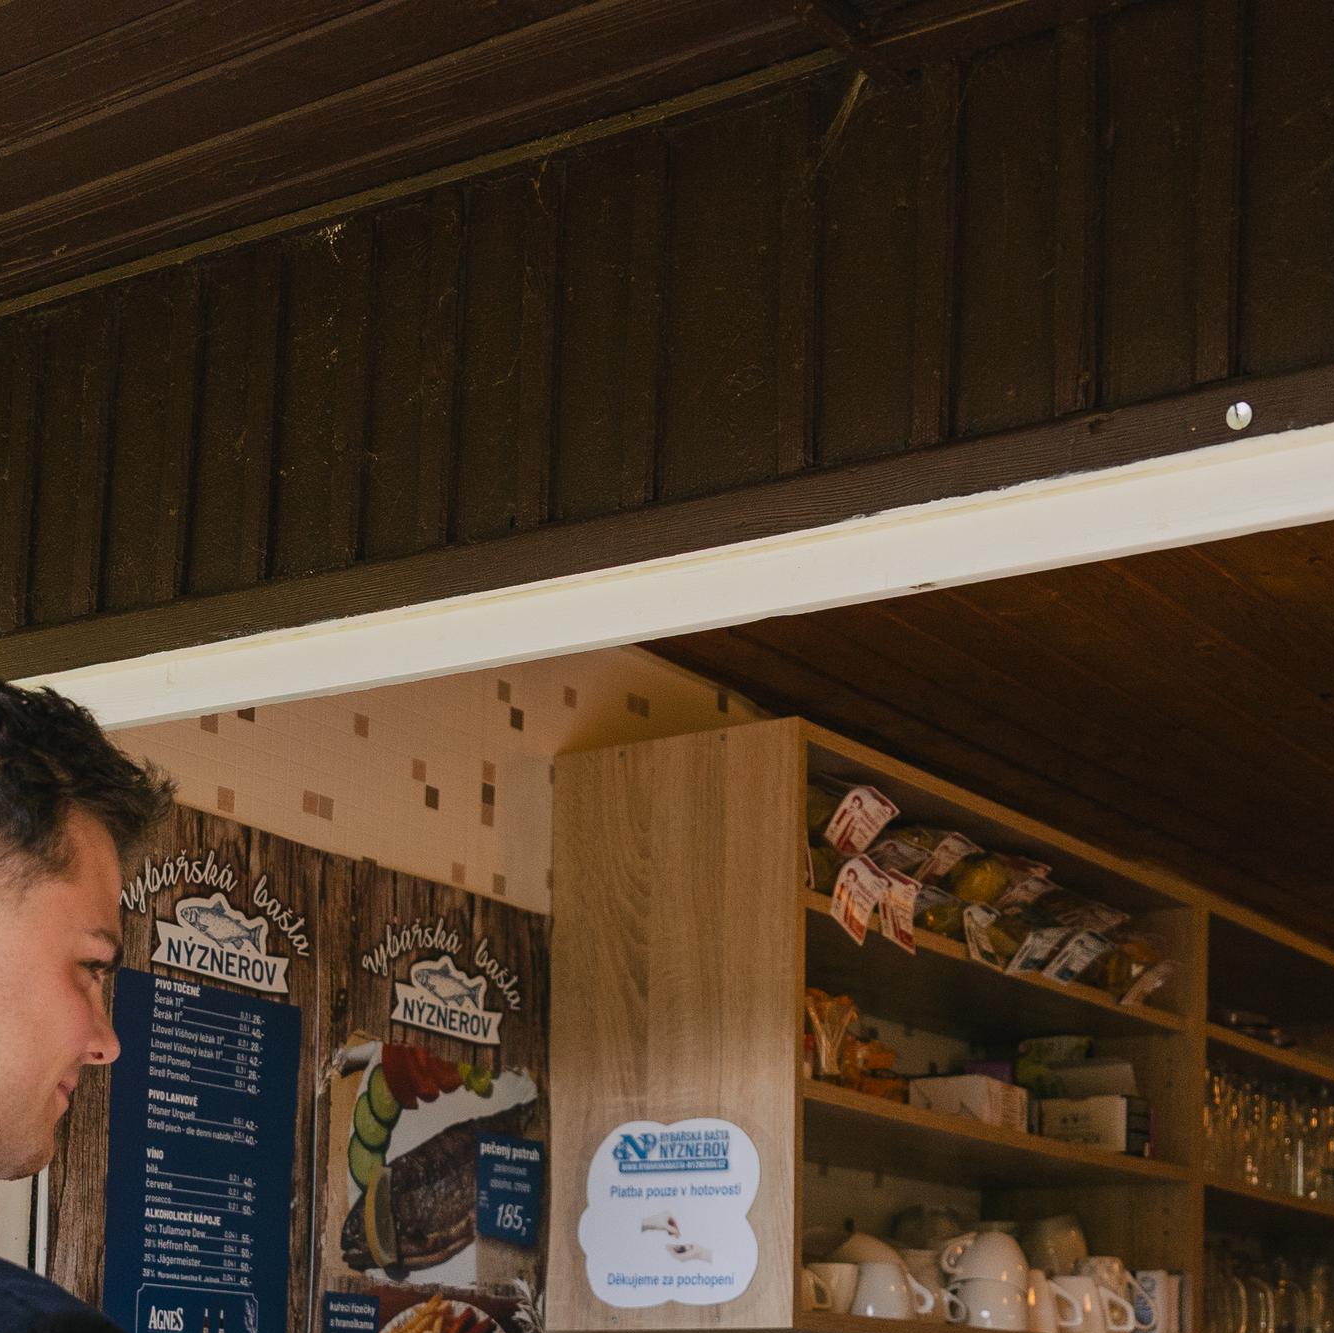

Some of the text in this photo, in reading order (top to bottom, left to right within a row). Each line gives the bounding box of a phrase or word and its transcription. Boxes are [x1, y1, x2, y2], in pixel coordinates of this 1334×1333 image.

[166, 936, 278, 987] NÝZNEROV
[155, 978, 172, 990] PIVO
[154, 990, 173, 1006] Šerák
[153, 1005, 172, 1021] Šerák
[402, 996, 493, 1039] NÝZNEROV
[151, 1023, 173, 1035] Litovel
[150, 1037, 172, 1050] Litovel
[167, 1054, 191, 1068] Pomelo
[166, 1068, 190, 1082] Pomelo
[148, 1088, 165, 1101] PIVO
[147, 1103, 170, 1116] Pilsner
[659, 1142, 730, 1159] NÝZNEROV
[610, 1184, 643, 1198] Platba
[646, 1185, 678, 1199] pouze
[691, 1183, 742, 1196] hotovosti
[496, 1203, 531, 1235] 185,-
[607, 1272, 735, 1288] Děkujeme za pochopení
[148, 1305, 183, 1332] AGNES
